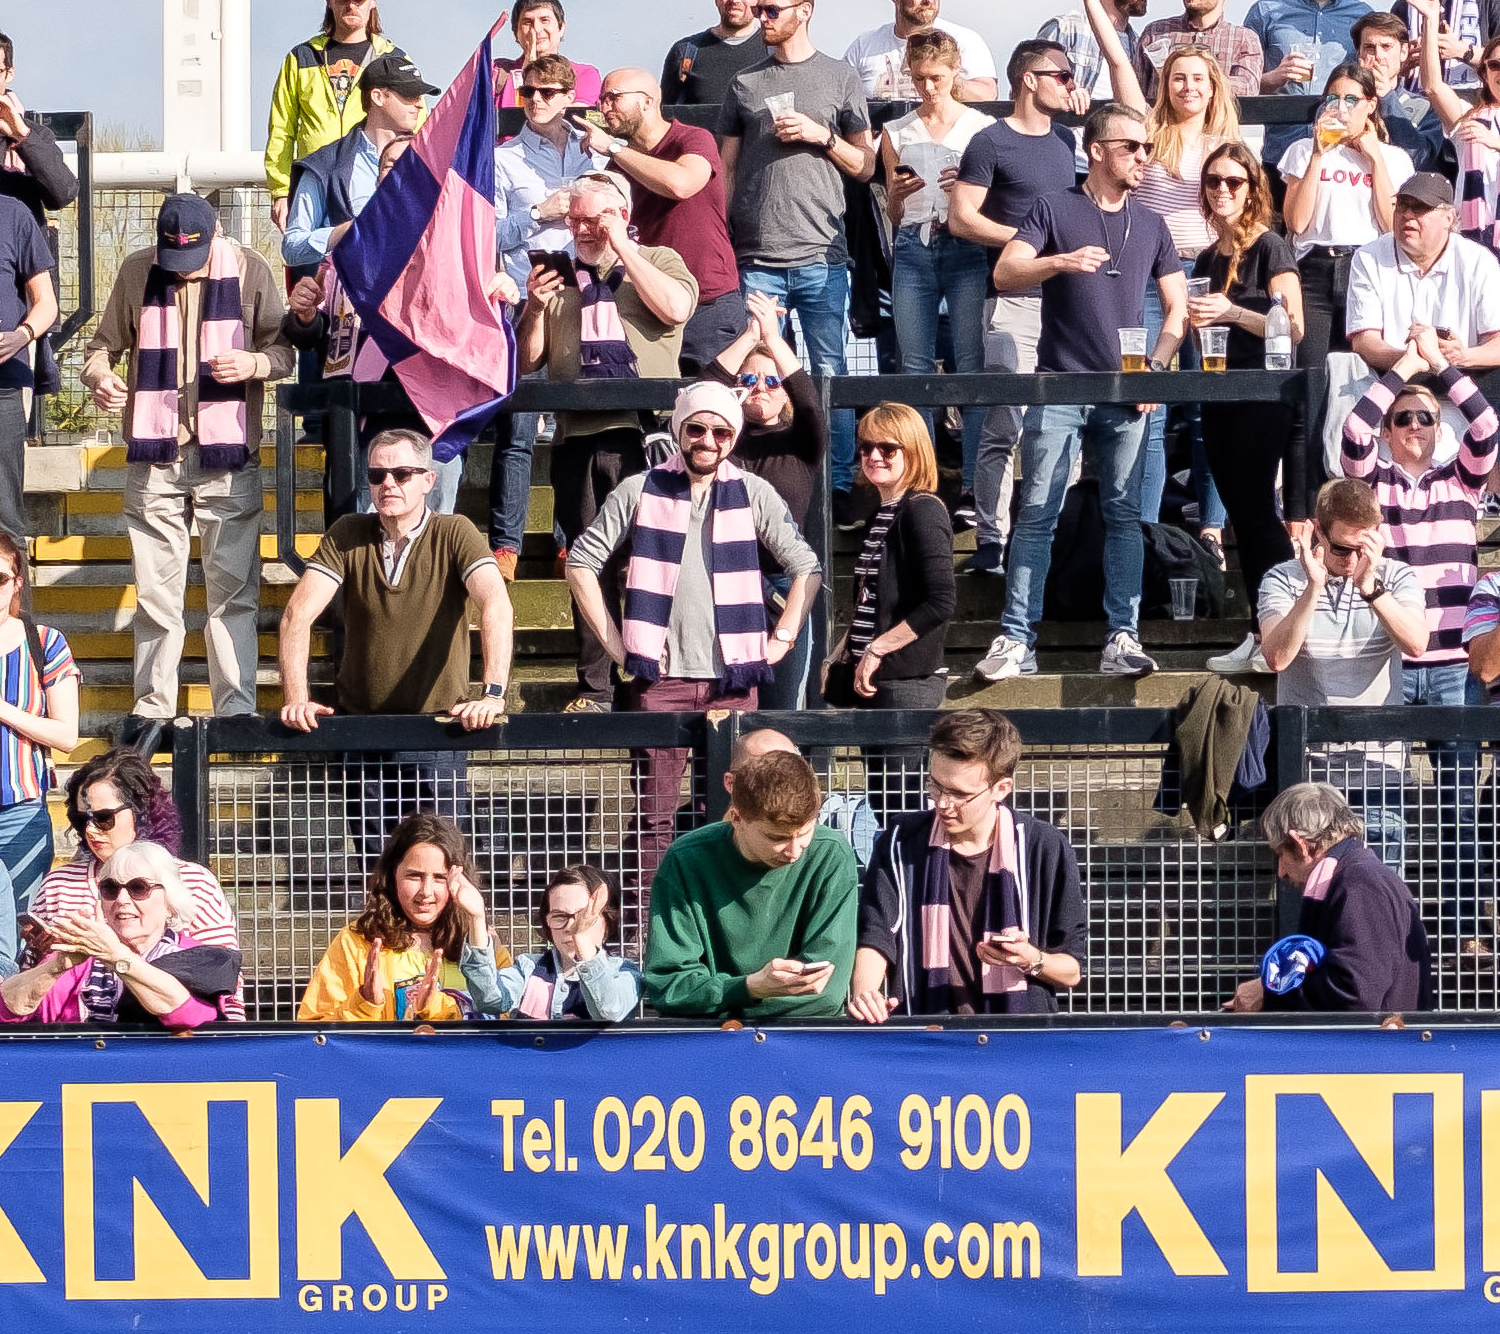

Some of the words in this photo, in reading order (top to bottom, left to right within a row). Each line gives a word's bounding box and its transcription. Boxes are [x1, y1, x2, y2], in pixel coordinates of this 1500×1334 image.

[491, 1099, 578, 1173] Tel.
[592, 1096, 706, 1172] 020
[729, 1094, 874, 1172] 8646
[898, 1092, 1031, 1171] 9100
[484, 1202, 1041, 1296] www.knkgroup.com
[298, 1283, 448, 1312] GROUP
